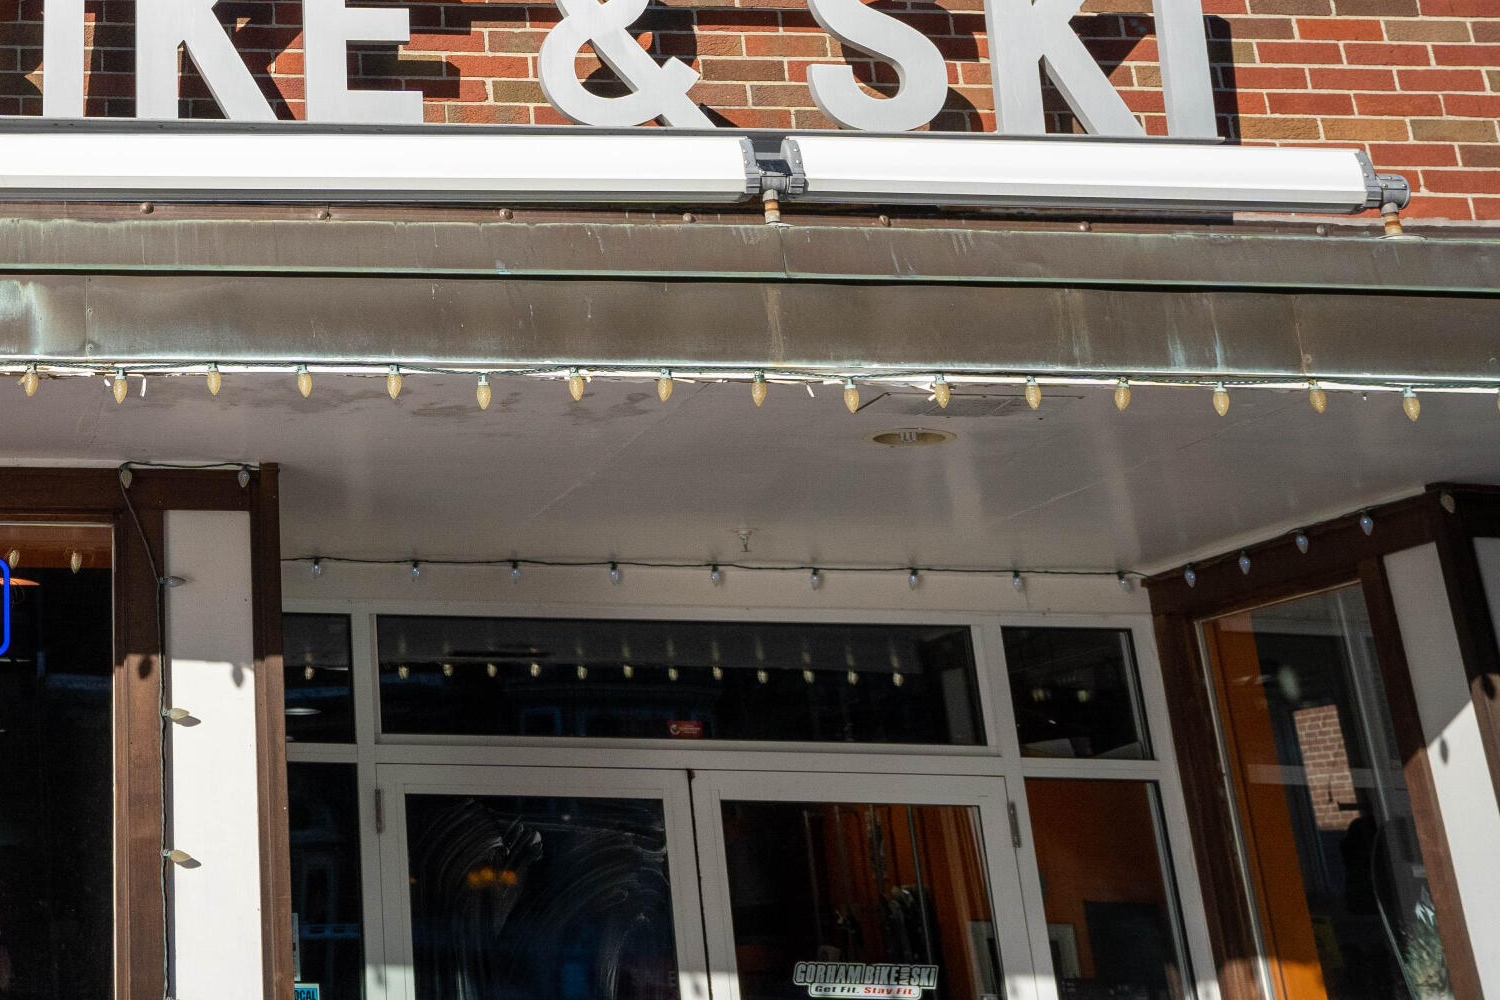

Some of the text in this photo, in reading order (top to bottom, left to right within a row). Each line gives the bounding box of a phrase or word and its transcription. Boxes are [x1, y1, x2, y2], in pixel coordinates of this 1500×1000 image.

[795, 963, 864, 984] GORHAM
[815, 985, 837, 993] Get
[864, 986, 893, 995] Stay
